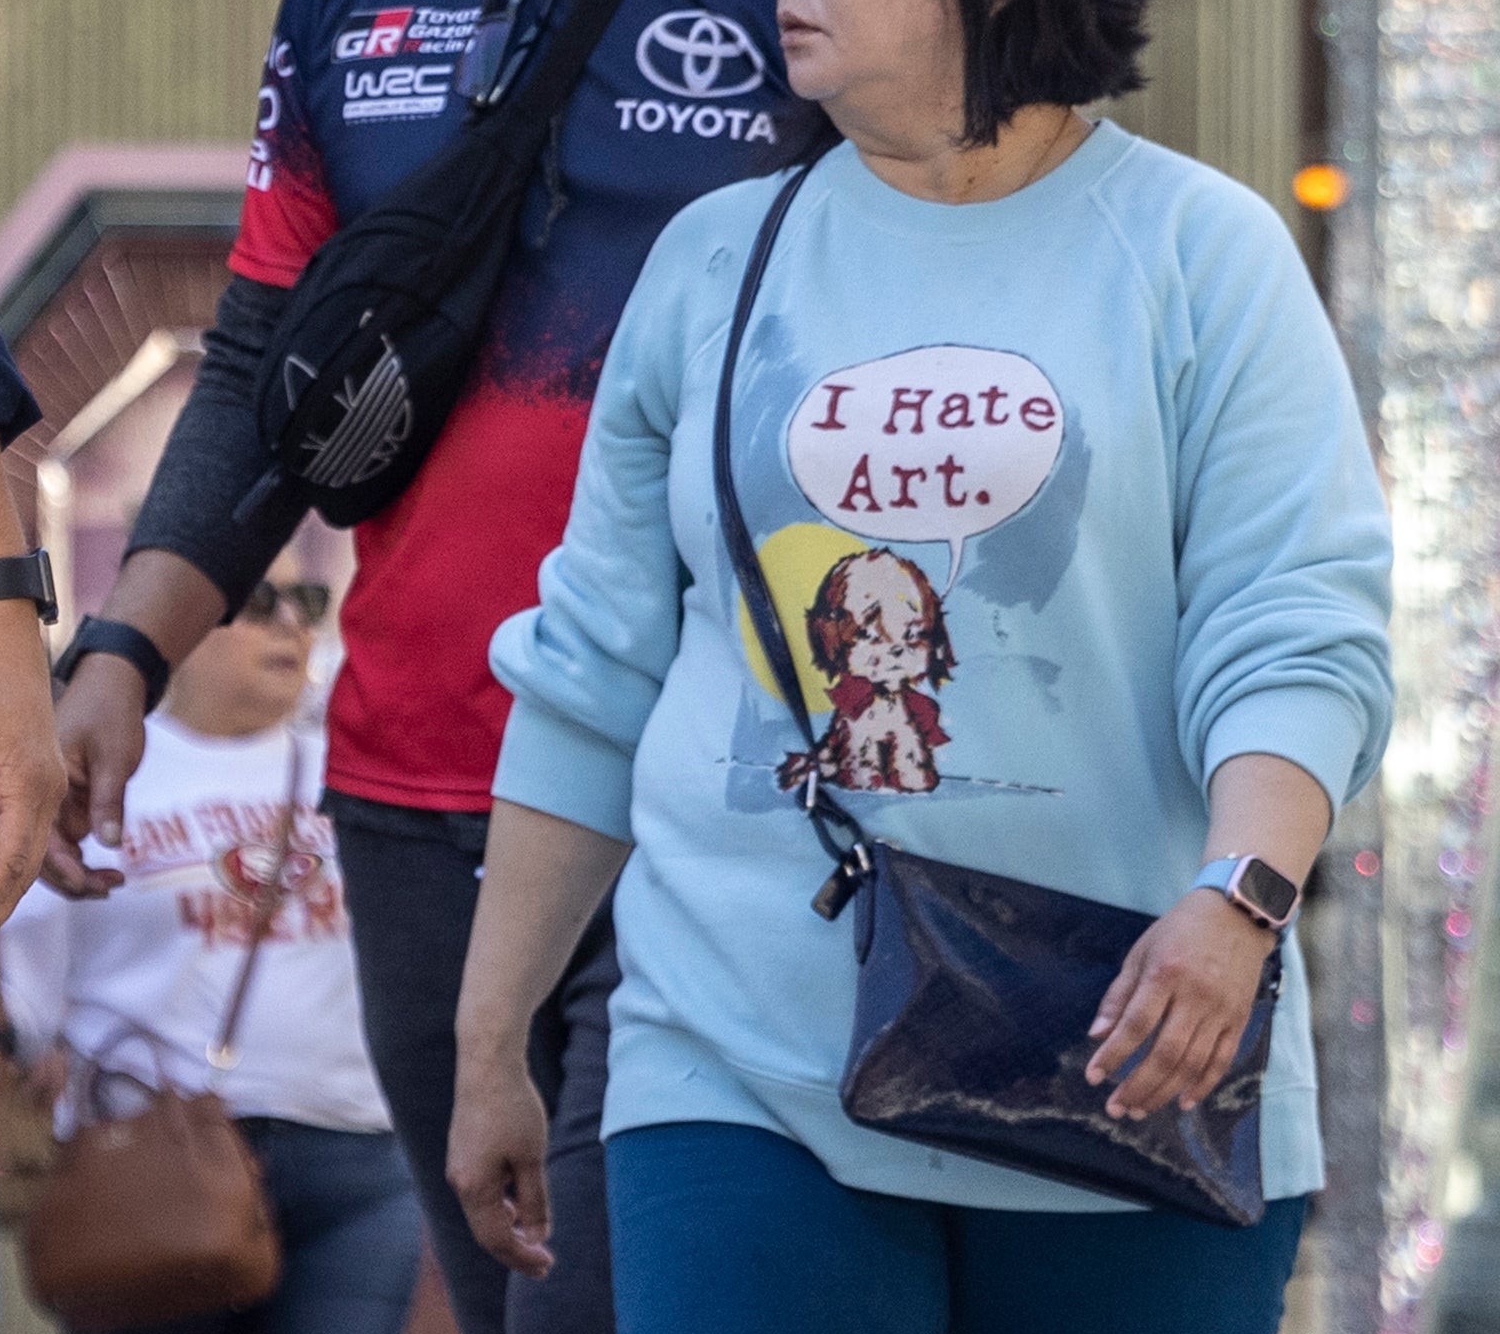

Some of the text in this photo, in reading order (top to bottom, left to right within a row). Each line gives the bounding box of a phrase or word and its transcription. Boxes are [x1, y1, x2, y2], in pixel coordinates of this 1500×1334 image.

[407, 23, 476, 40] GAZO
[416, 6, 482, 25] TOYOT
[336, 27, 402, 59] GR
[344, 65, 453, 99] WRC
[614, 97, 777, 145] TOYOTA
[811, 384, 1056, 435] I Hate
[837, 453, 992, 513] Art.
